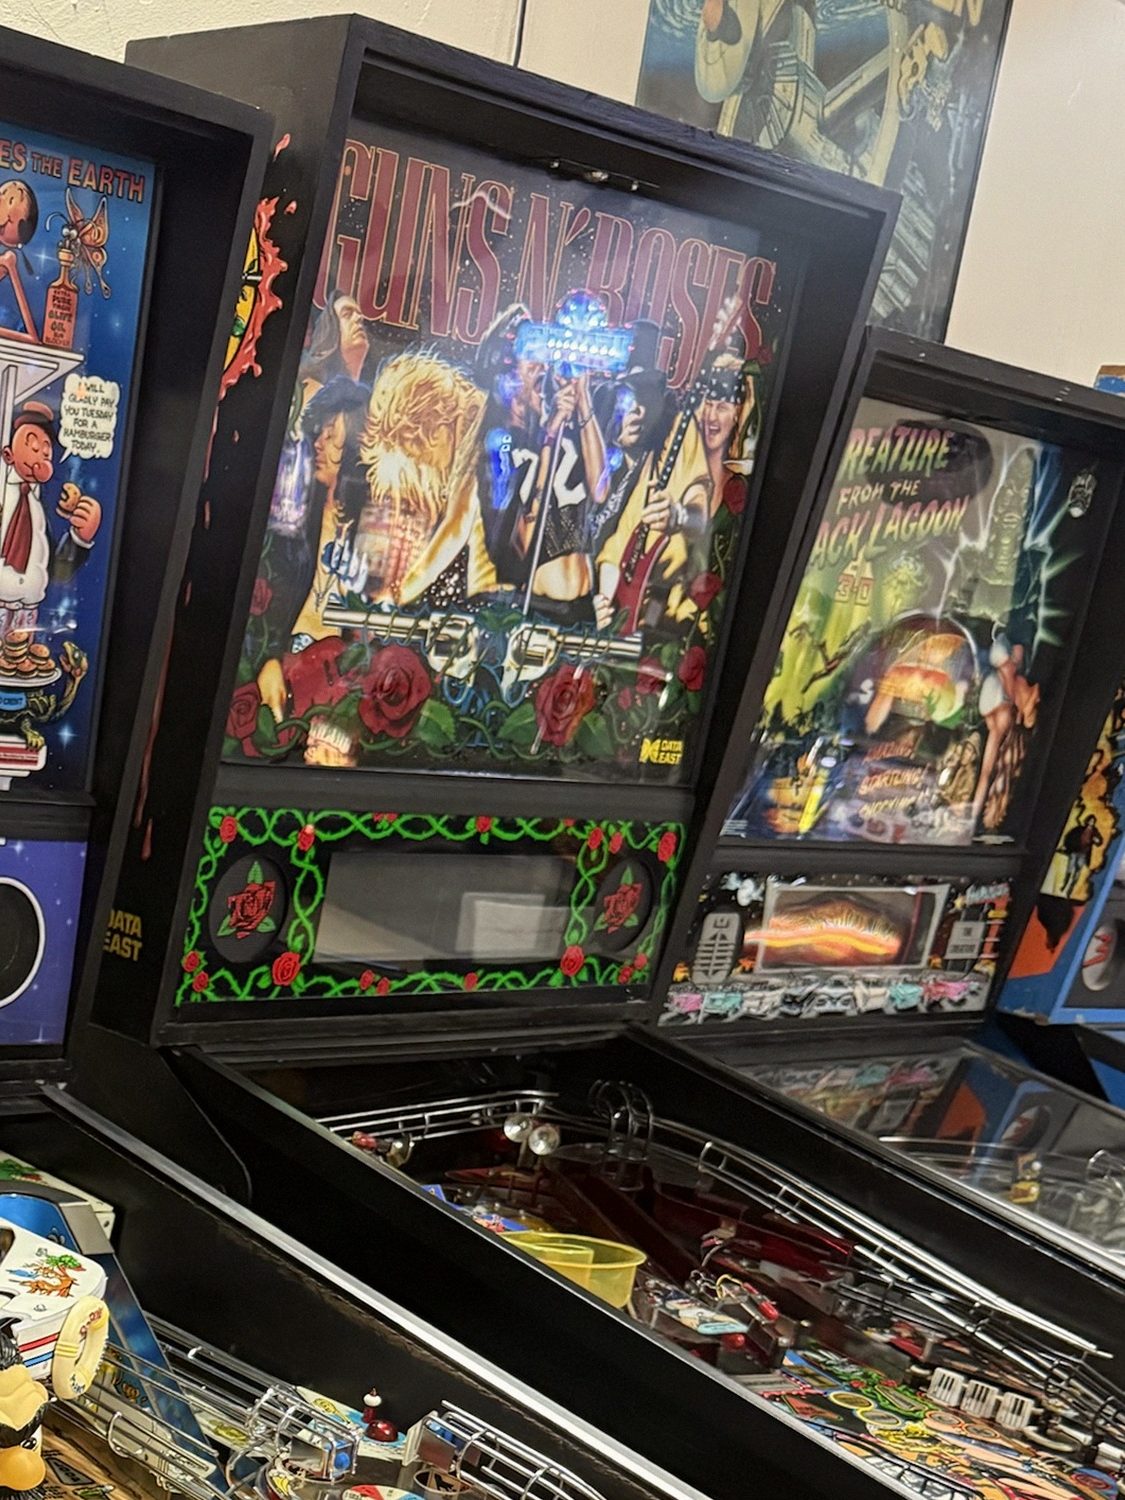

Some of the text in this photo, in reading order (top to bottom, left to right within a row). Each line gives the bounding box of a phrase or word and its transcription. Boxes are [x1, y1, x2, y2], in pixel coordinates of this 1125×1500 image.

[32, 152, 62, 178] THE
[67, 156, 145, 203] EARTH
[313, 140, 513, 345] GUNS
[585, 211, 775, 390] ROSES
[64, 405, 80, 416] YOU
[73, 418, 98, 429] FOR A
[837, 425, 955, 481] REATURE
[836, 479, 921, 515] FROM THE
[863, 494, 971, 561] LAGOON
[657, 750, 683, 764] EAST
